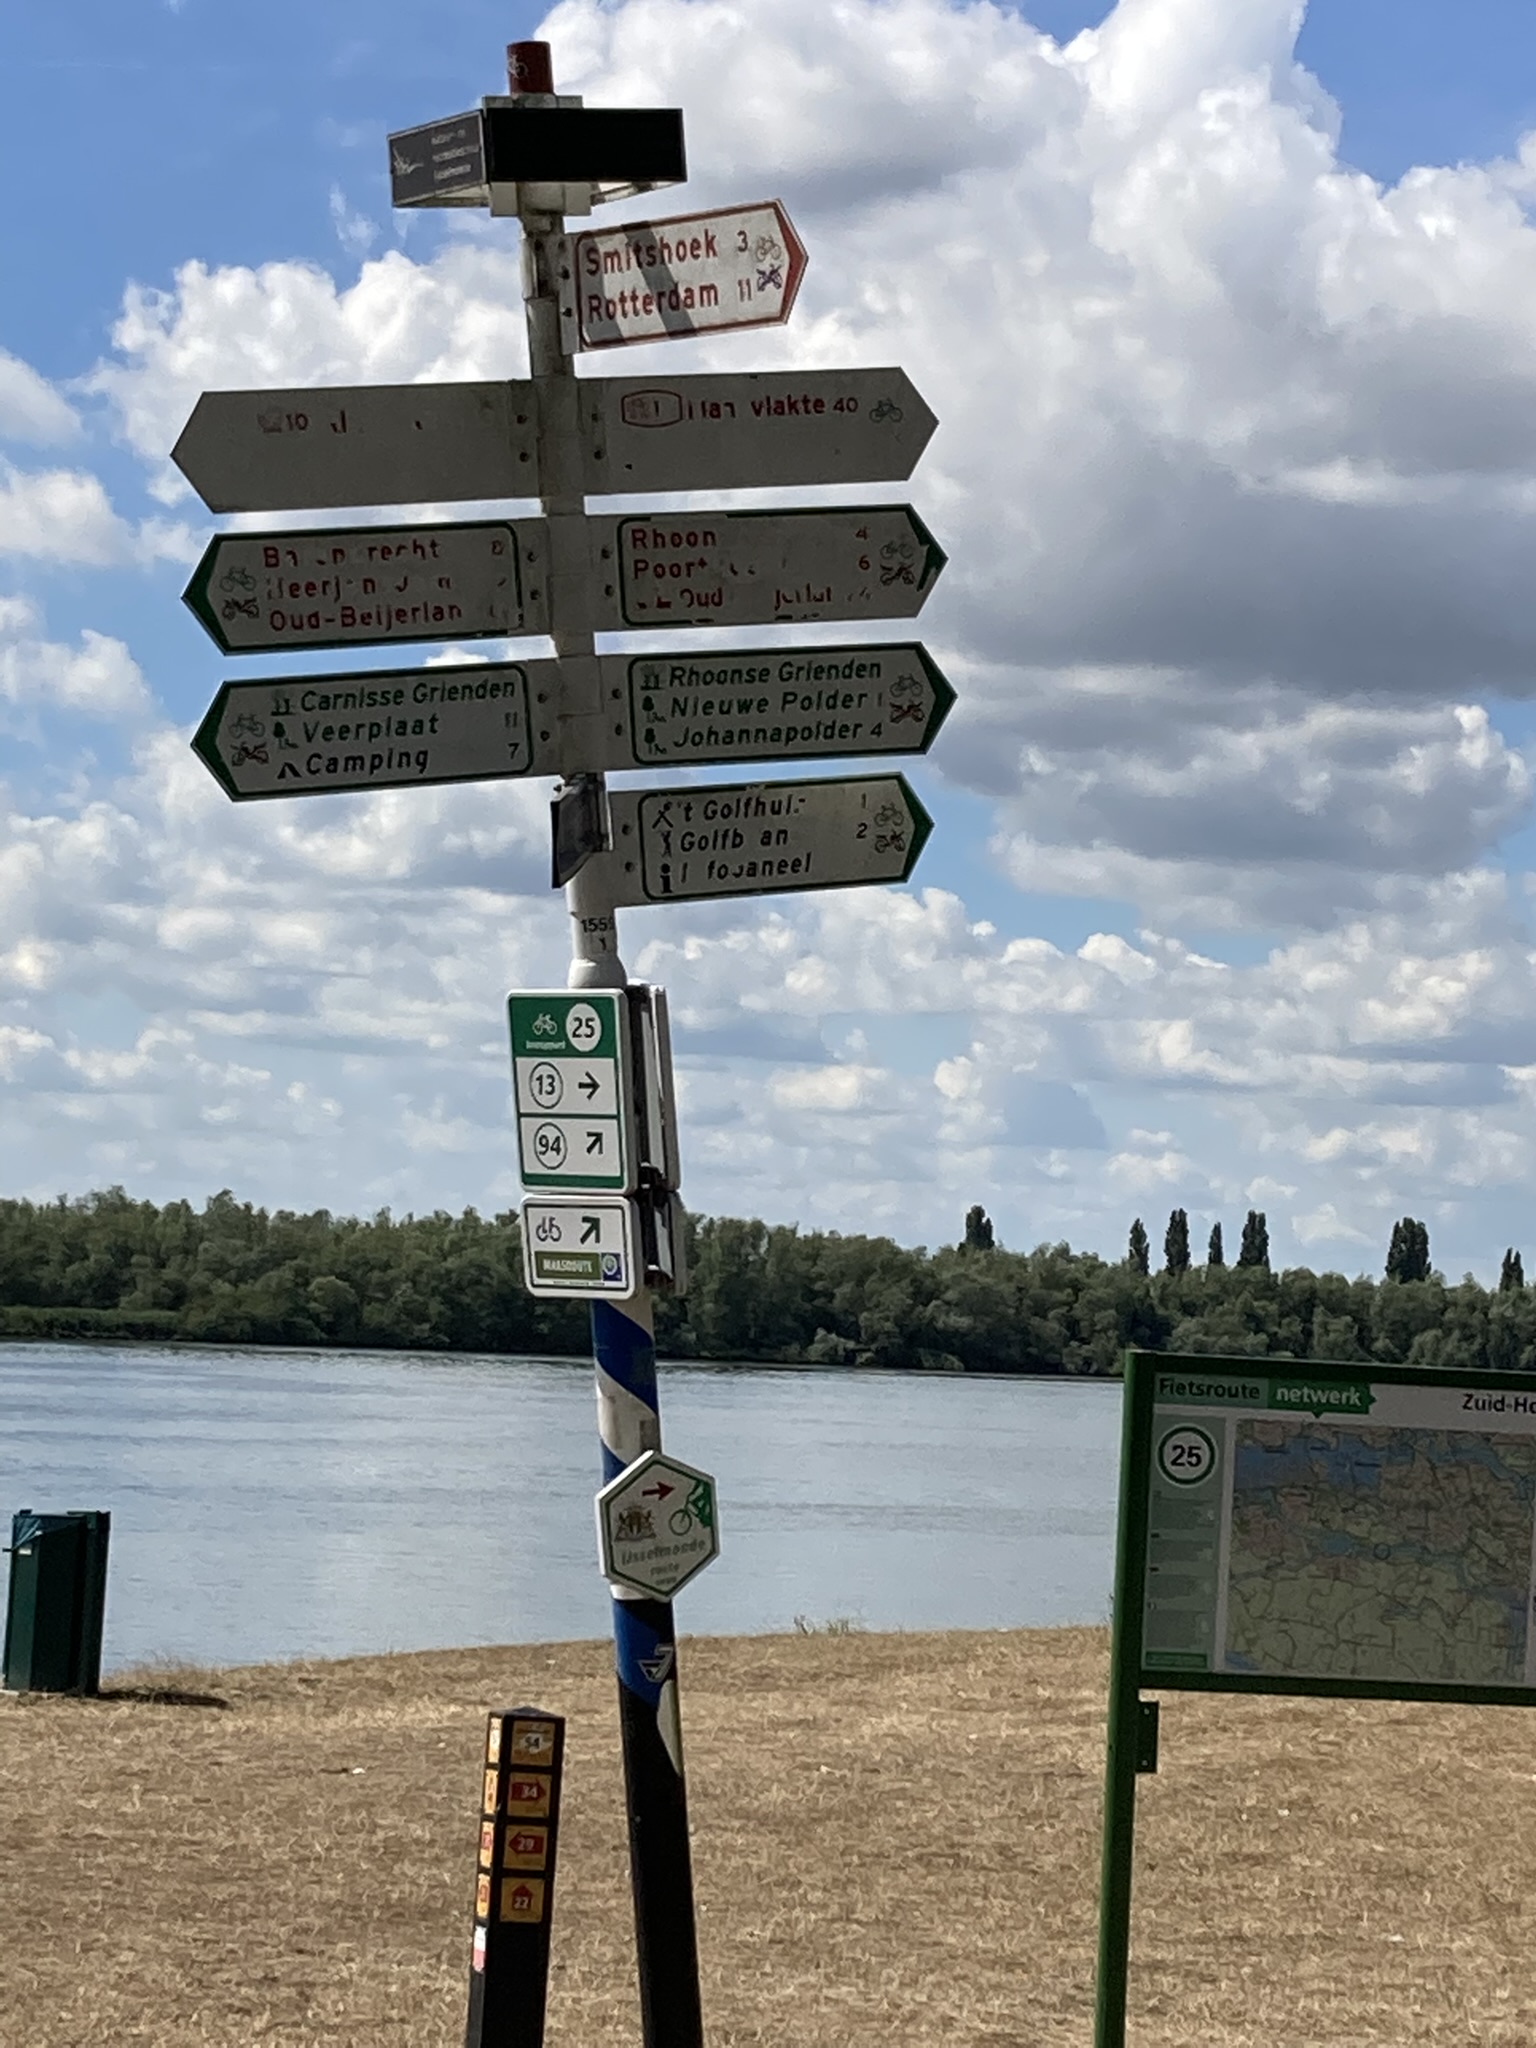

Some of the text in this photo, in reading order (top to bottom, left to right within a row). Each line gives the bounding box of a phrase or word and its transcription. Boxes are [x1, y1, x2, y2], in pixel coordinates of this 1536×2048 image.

[586, 228, 749, 276] Smitshoek 3
[588, 277, 752, 324] Rotterdam 11
[832, 397, 859, 414] 40
[631, 528, 717, 549] Rhoon
[858, 554, 870, 571] 6
[669, 658, 881, 688] Rhoonse Grienden
[300, 678, 515, 712] Carnisse Grienden
[671, 695, 770, 718] Nieuwe
[781, 688, 868, 713] Polder
[302, 712, 440, 743] Veerplaat
[672, 719, 883, 748] Johannapolder 4
[306, 742, 520, 775] Camping 7
[856, 822, 868, 839] 2
[571, 1016, 596, 1039] 25
[535, 1074, 556, 1096] 13
[538, 1134, 562, 1156] 94
[1158, 1377, 1362, 1407] Fietsroute netwerk
[1170, 1444, 1203, 1468] 25
